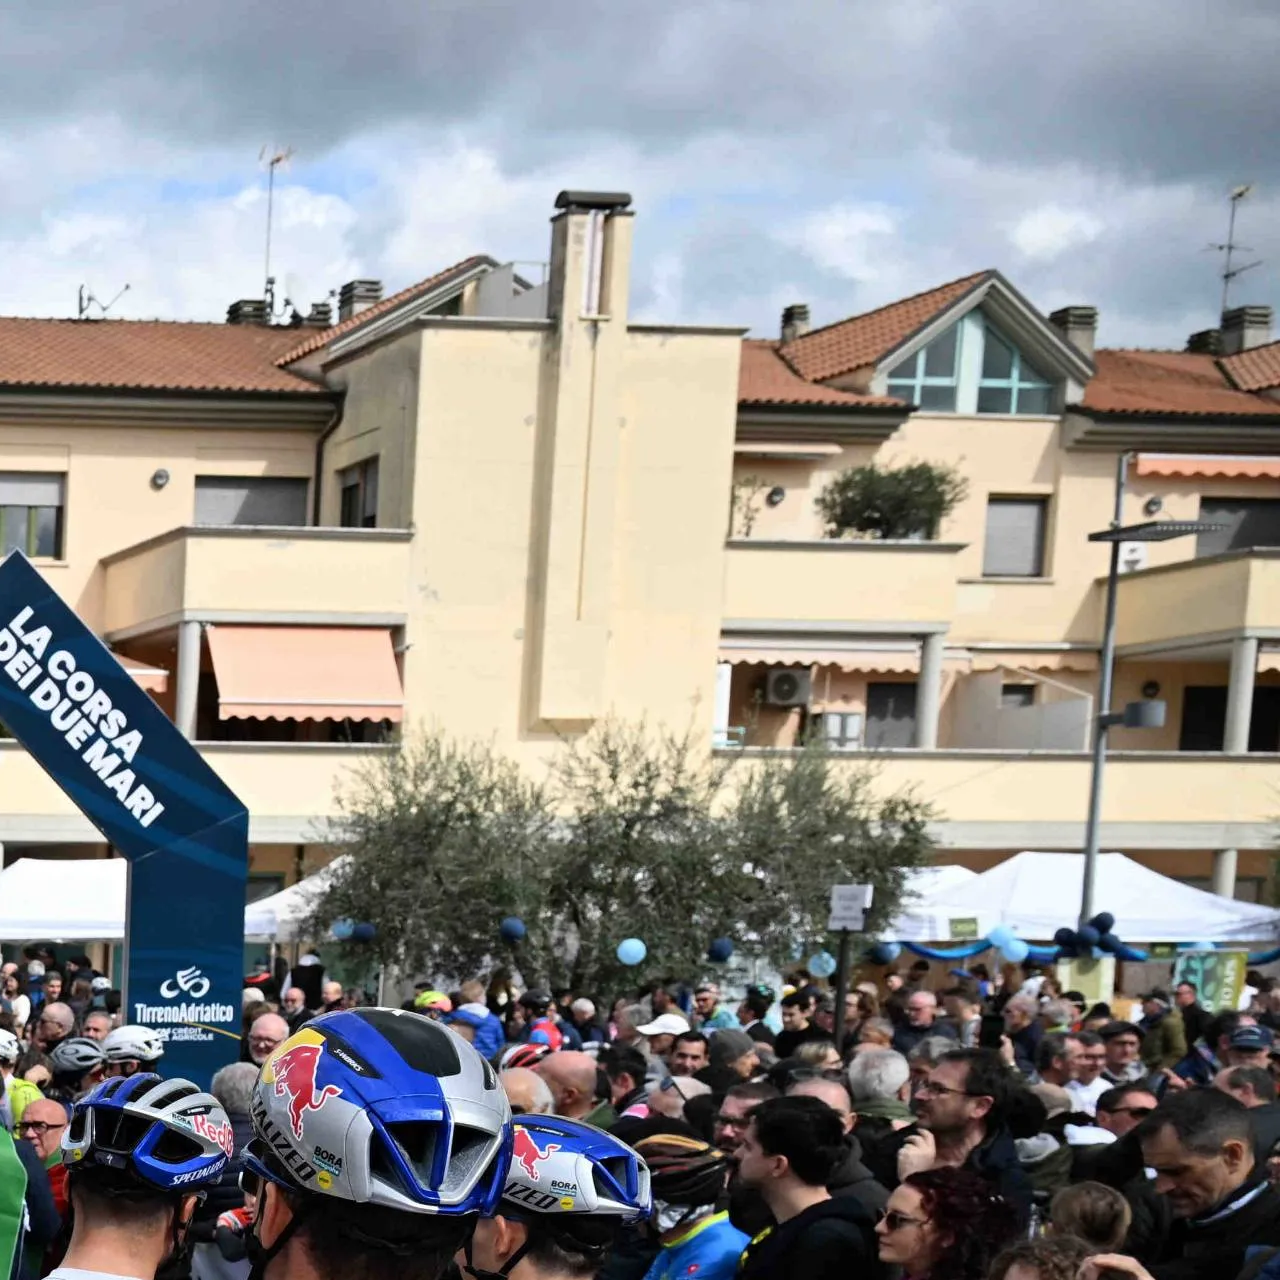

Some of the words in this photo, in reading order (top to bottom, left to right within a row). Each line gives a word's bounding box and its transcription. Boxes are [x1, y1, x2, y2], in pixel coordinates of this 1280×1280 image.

[8, 605, 51, 660] LA
[47, 648, 145, 766] CORSA
[28, 675, 96, 750] DUE
[81, 741, 166, 829] MARI
[134, 1002, 234, 1025] TirrenoAdriatico
[313, 1145, 344, 1169] BORA
[550, 1179, 579, 1192] BORA
